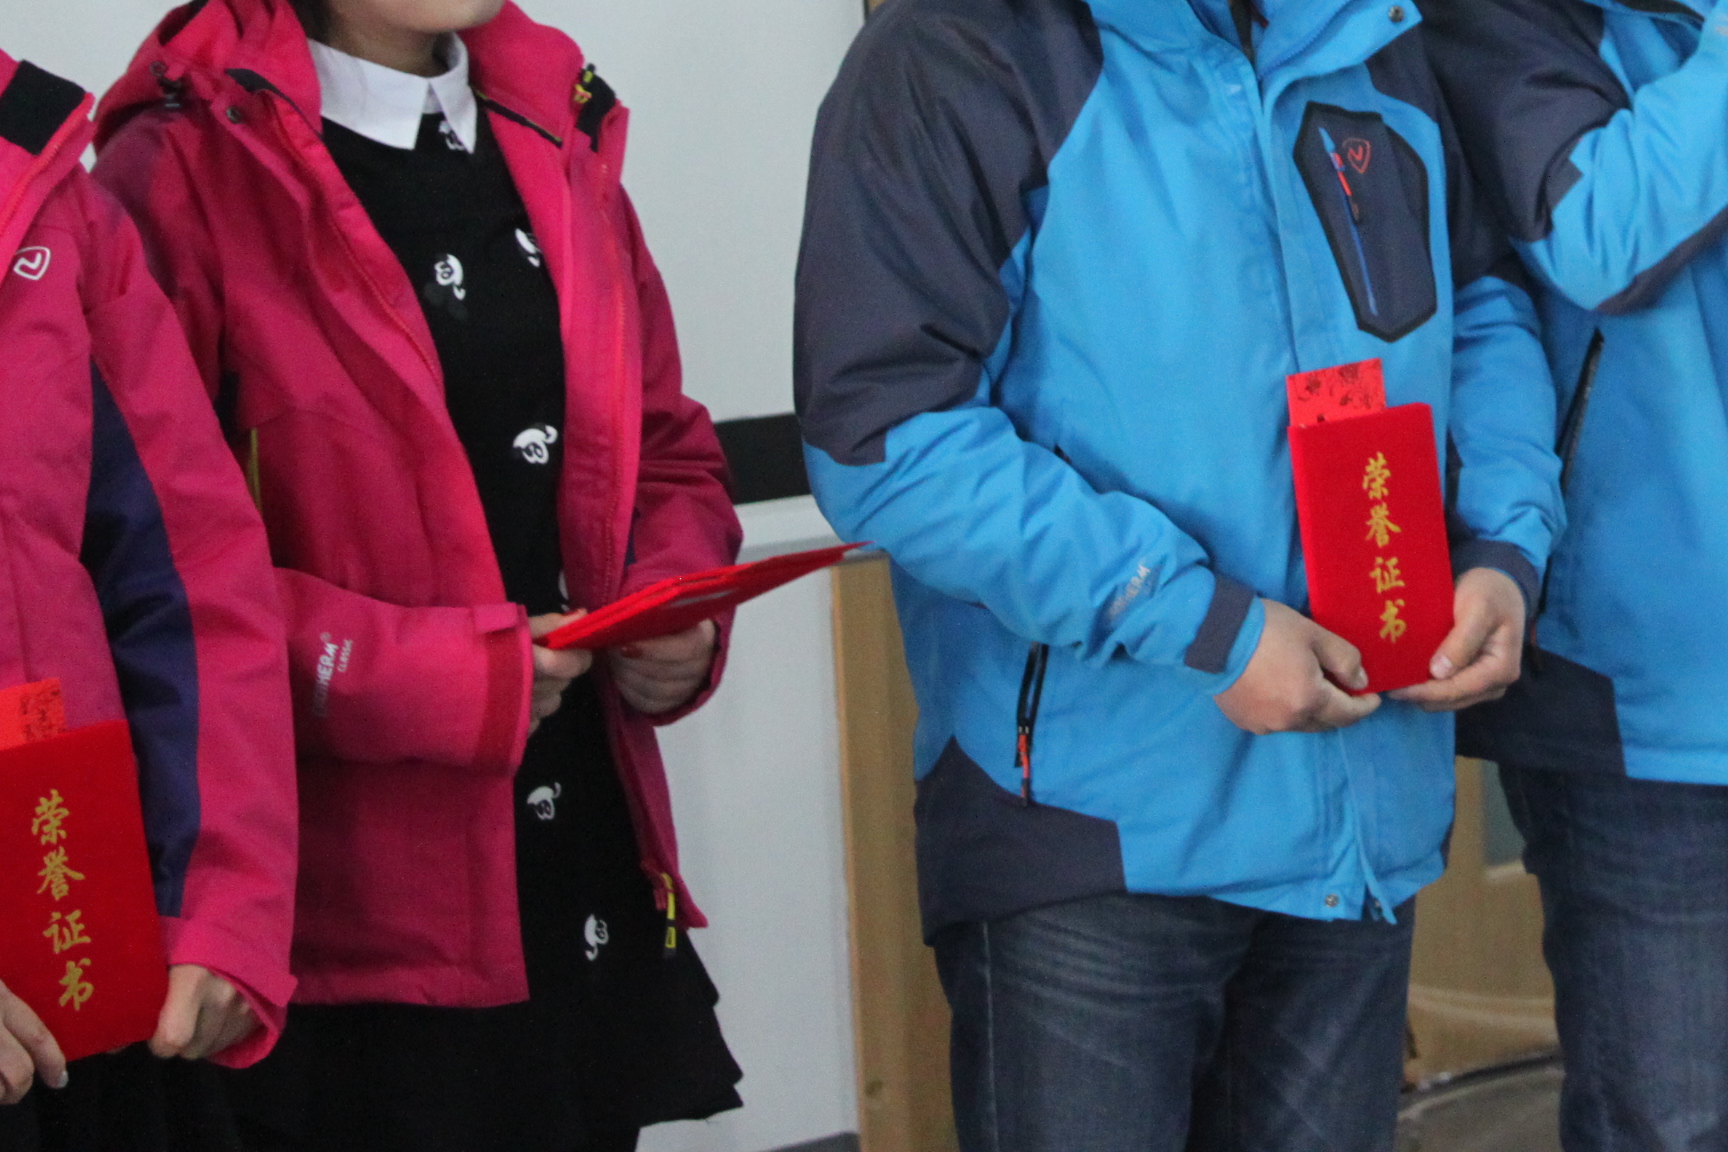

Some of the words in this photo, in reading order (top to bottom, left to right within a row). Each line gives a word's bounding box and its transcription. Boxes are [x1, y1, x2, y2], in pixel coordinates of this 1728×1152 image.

[1362, 451, 1406, 643] 荣誉证书
[31, 789, 95, 1011] 荣誉证书
